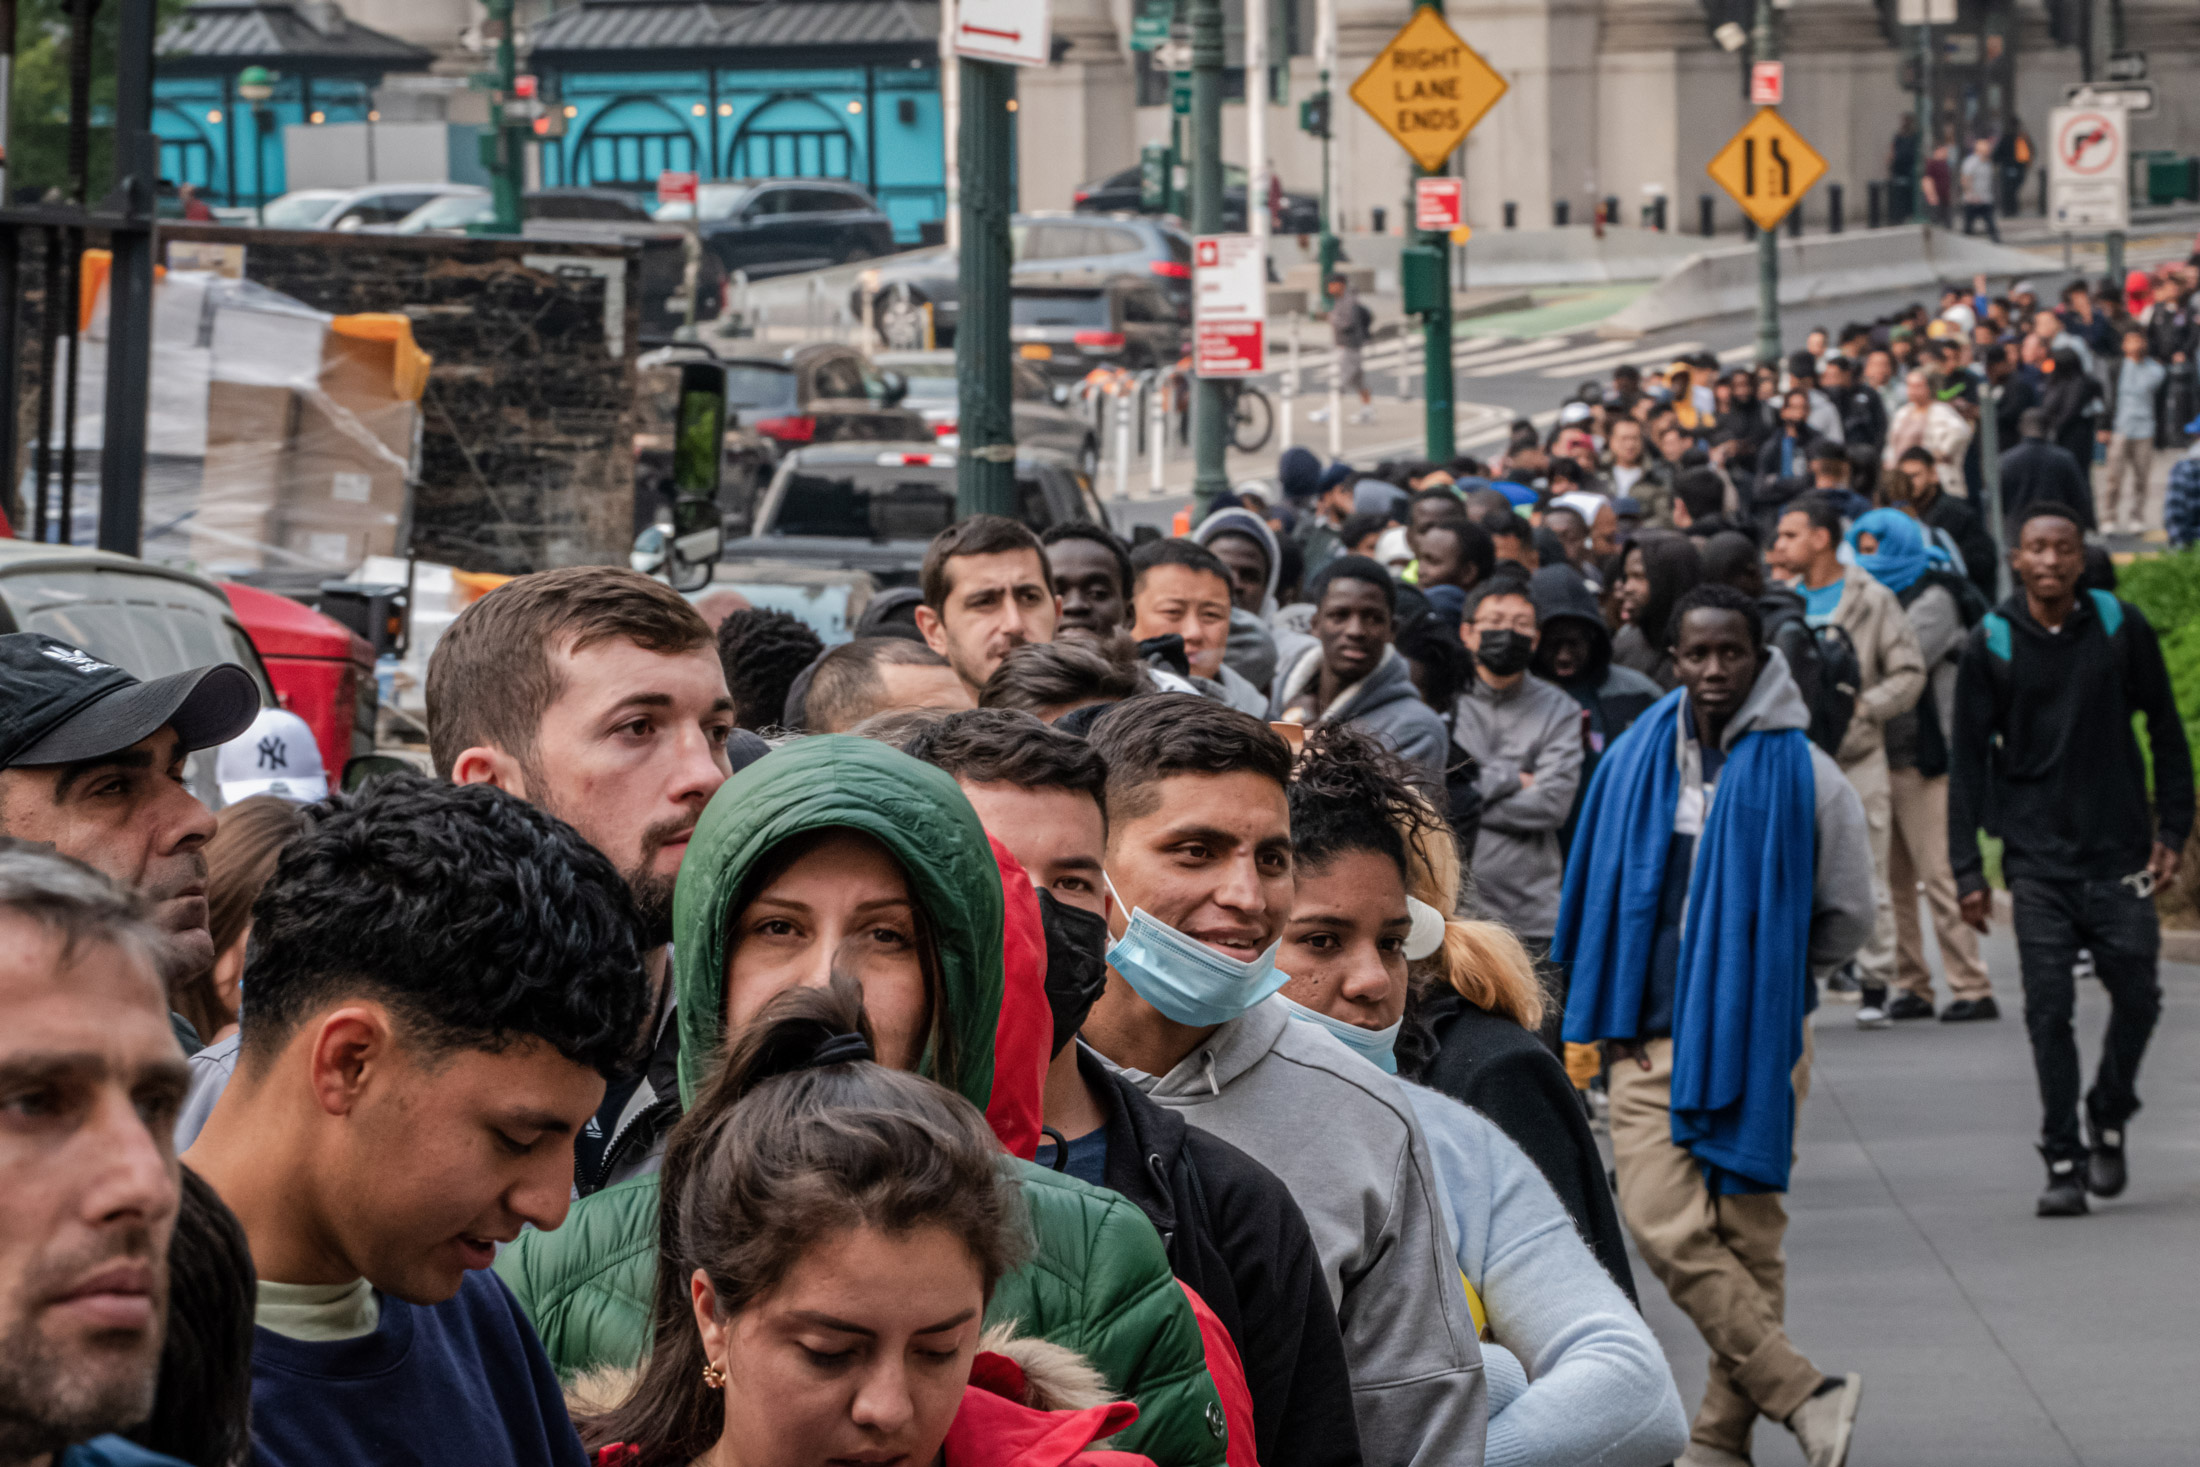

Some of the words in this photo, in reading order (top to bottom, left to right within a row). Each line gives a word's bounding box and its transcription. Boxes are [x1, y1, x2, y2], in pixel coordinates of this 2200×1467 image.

[1393, 47, 1460, 70] RIGHT
[1394, 77, 1460, 101] LANE
[1397, 108, 1460, 131] ENDS
[257, 736, 287, 769] NY
